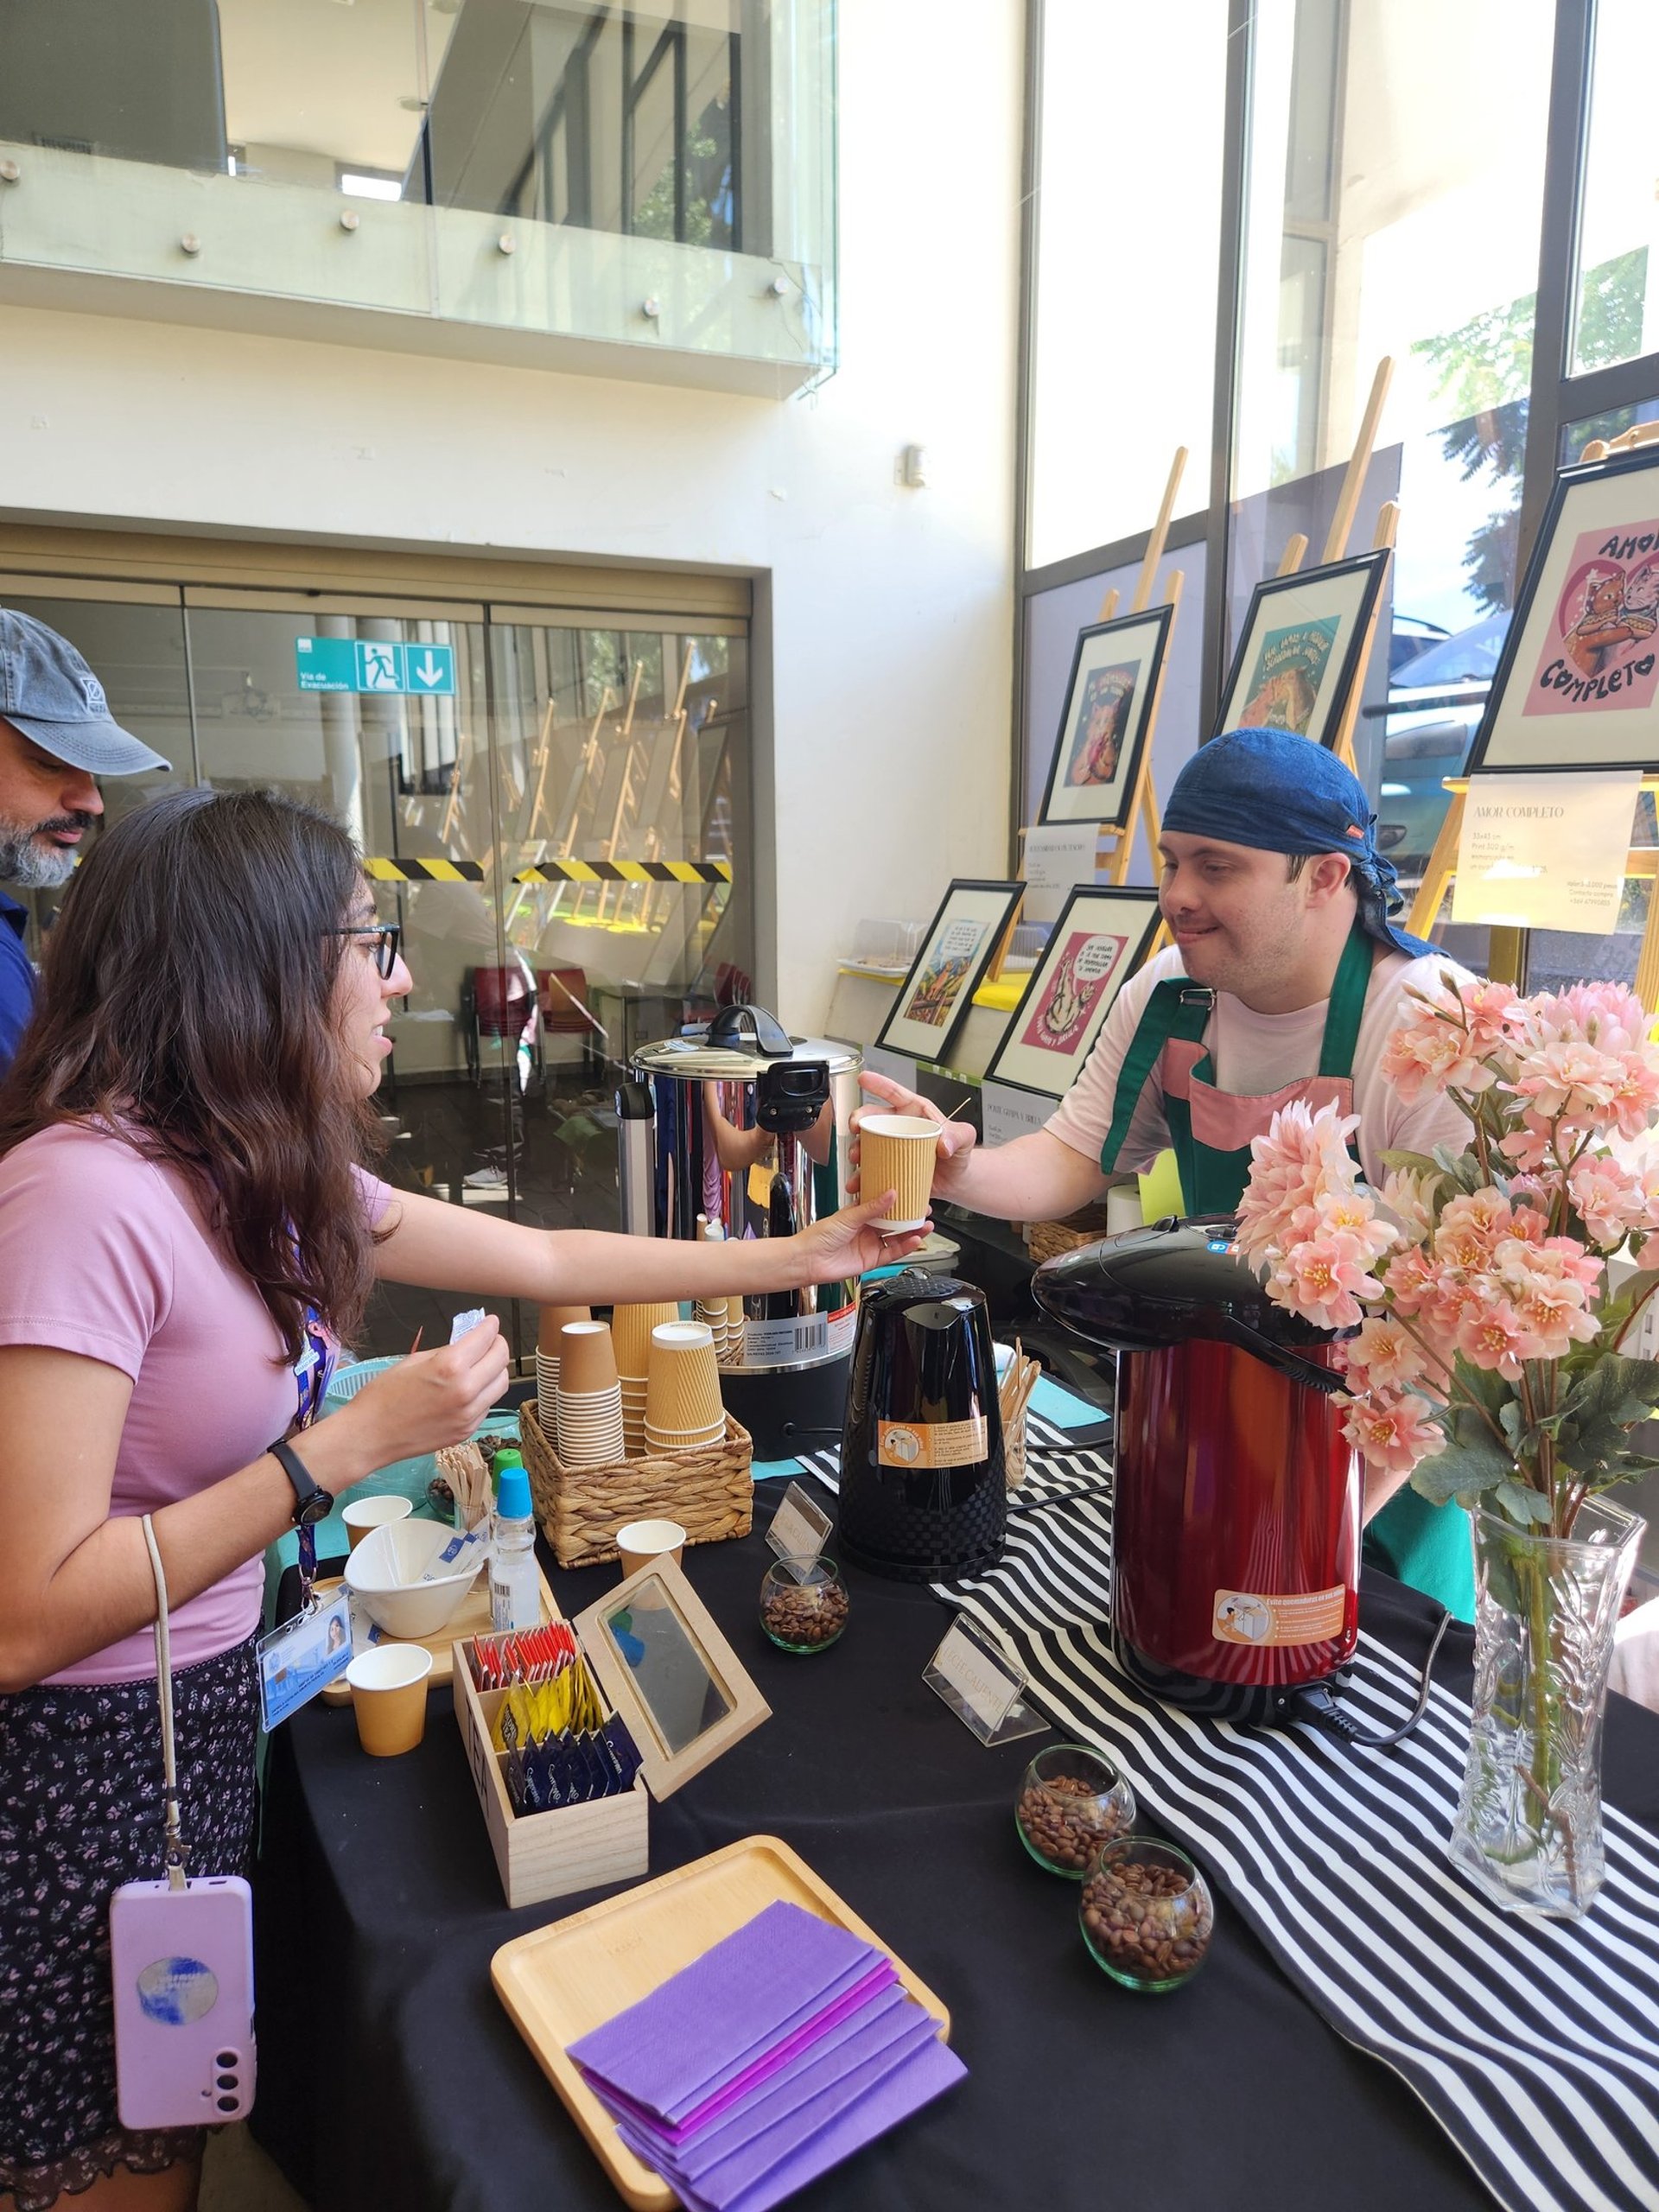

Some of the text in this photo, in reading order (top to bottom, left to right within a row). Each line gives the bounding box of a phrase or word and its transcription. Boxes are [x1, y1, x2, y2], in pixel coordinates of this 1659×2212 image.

[1541, 653, 1655, 702] COMPLETO
[1473, 805, 1565, 819] AMOR COMPLETO
